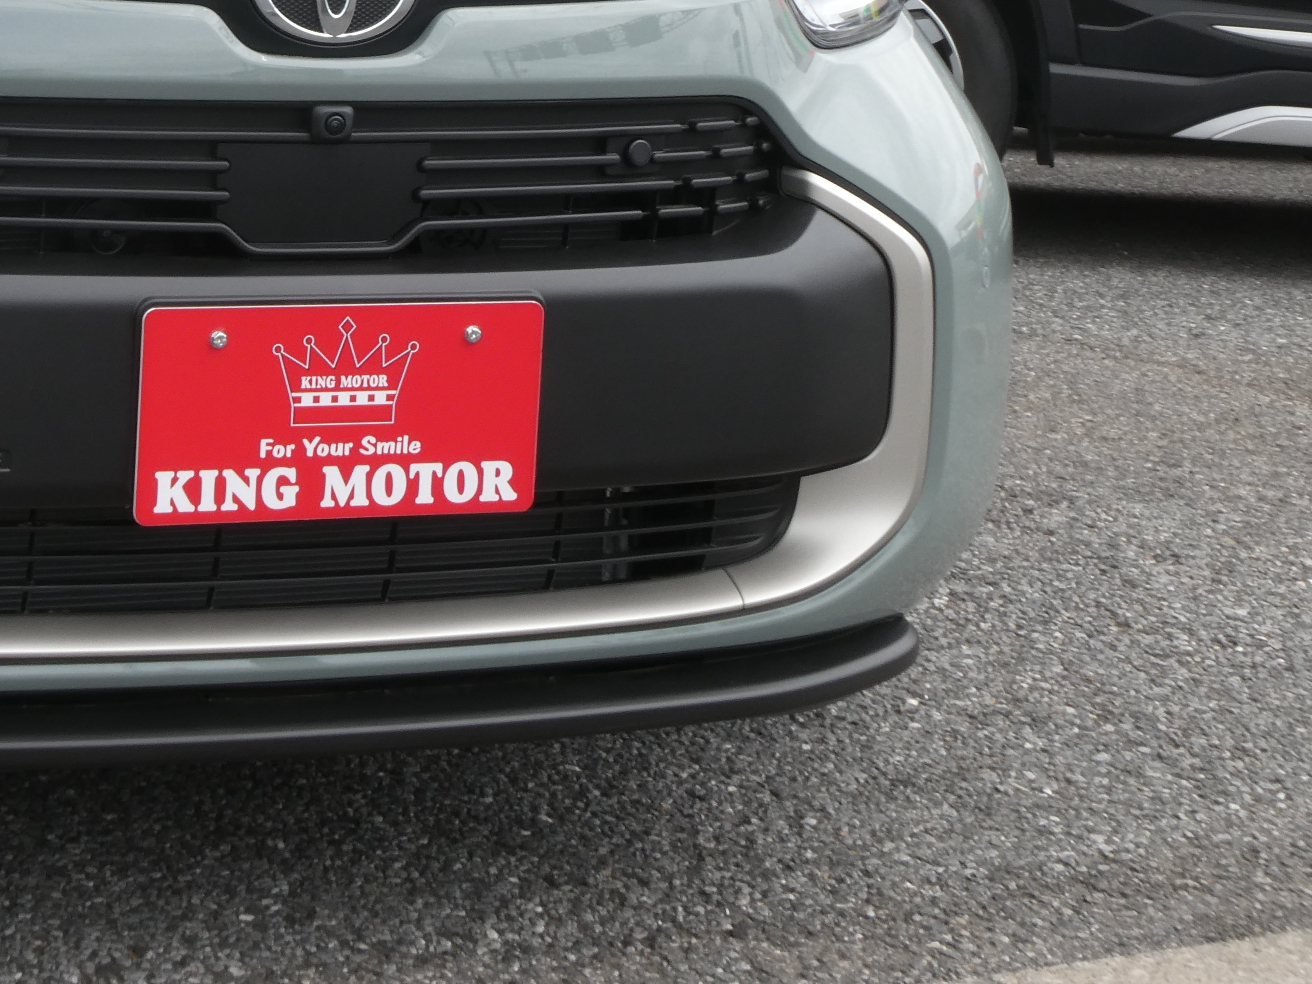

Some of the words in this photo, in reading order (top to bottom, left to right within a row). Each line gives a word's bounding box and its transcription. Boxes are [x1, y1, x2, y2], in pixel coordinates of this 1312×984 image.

[300, 374, 336, 390] KING
[339, 373, 389, 389] MOTOR
[259, 438, 296, 459] For
[301, 436, 354, 458] Your
[358, 434, 422, 456] Smile
[153, 465, 300, 514] KING
[320, 459, 518, 508] MOTOR
